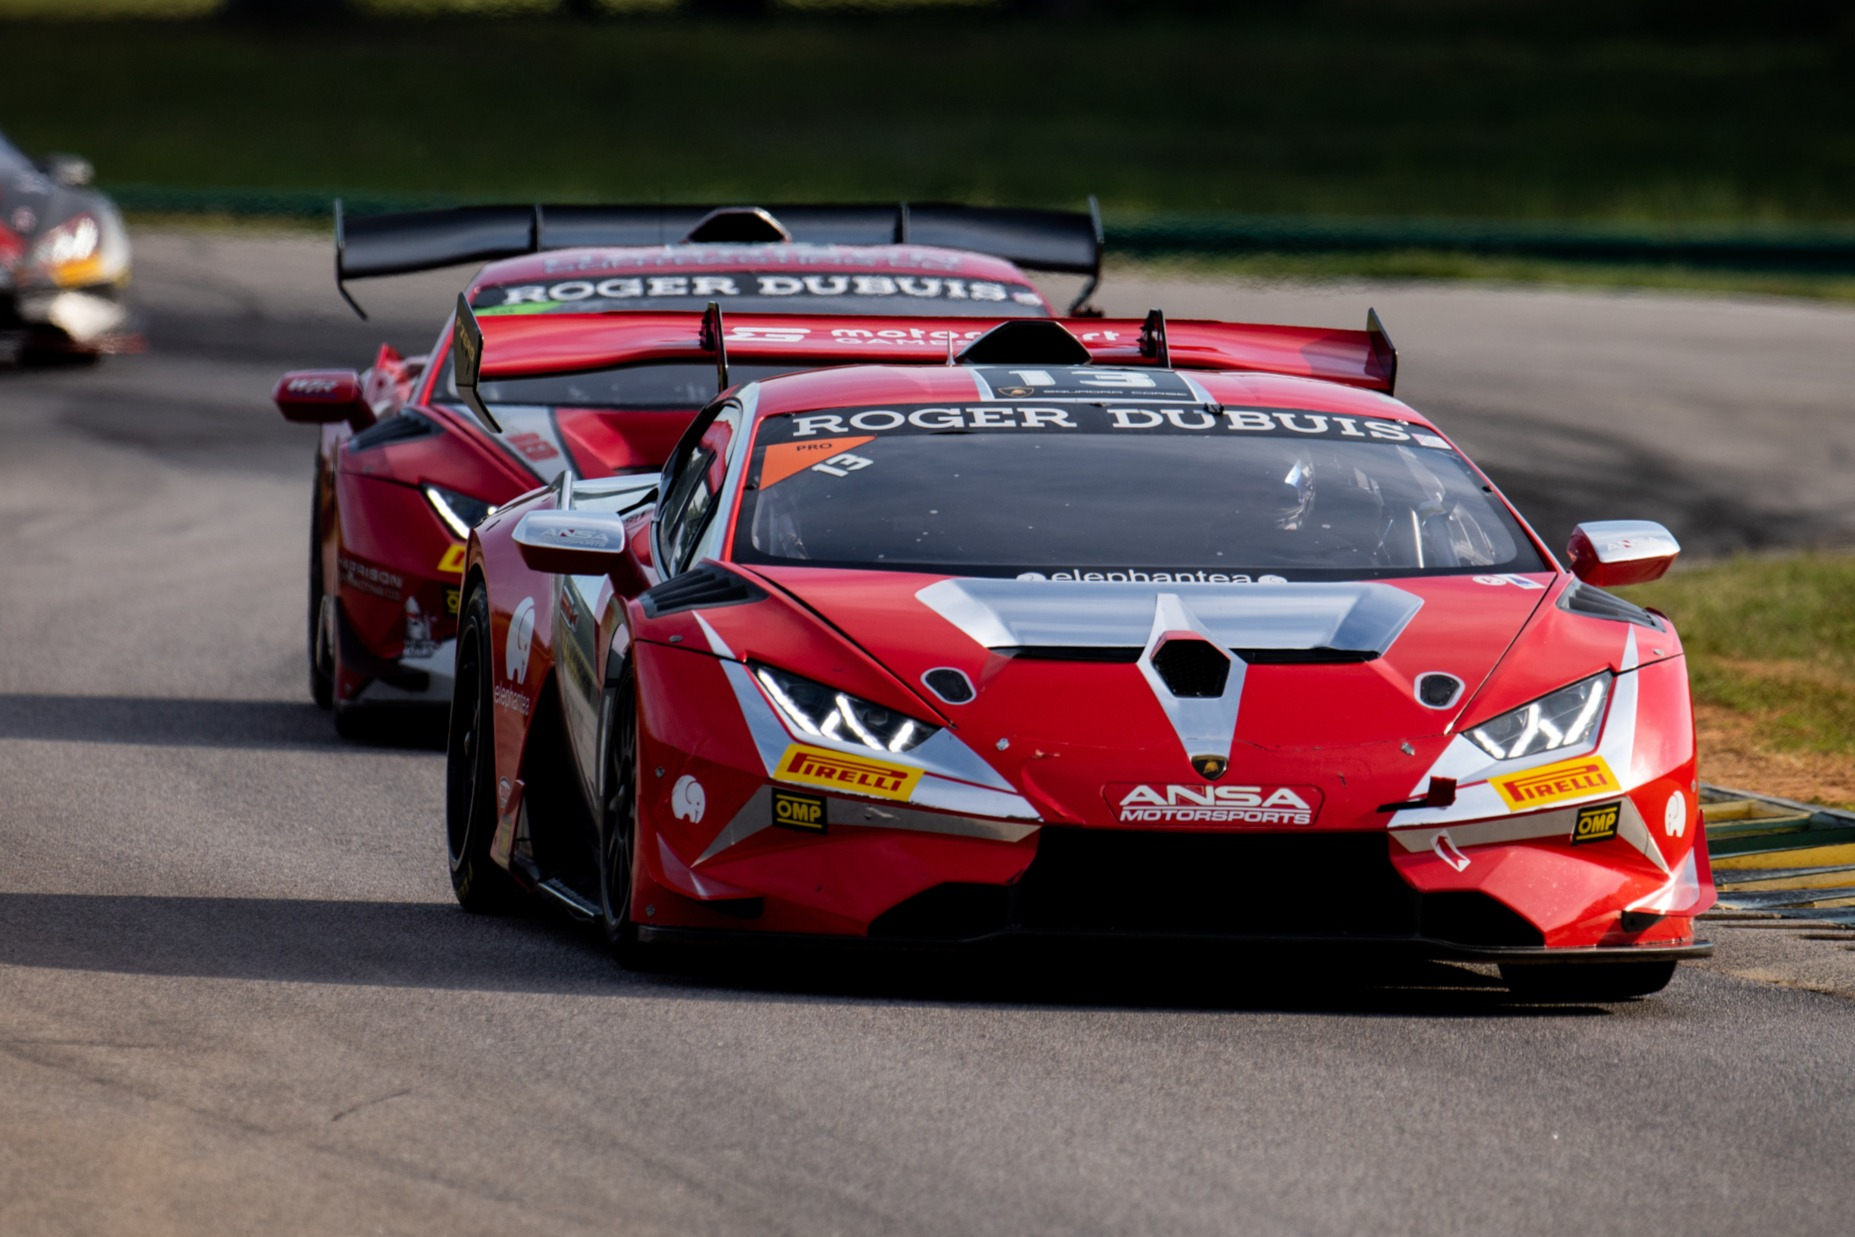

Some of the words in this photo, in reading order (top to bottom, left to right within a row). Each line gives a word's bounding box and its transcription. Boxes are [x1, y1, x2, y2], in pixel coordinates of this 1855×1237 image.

[503, 277, 739, 305] ROGER
[757, 275, 1006, 301] DUBUIS
[831, 328, 1120, 341] motorrt
[1008, 370, 1156, 387] 13
[793, 407, 1077, 437] ROGER
[1106, 408, 1410, 441] DUBUIS
[796, 442, 833, 452] PRO
[811, 453, 874, 478] 13
[1051, 569, 1251, 583] elephantea
[494, 681, 530, 716] elephantea
[786, 752, 908, 792] PIRELLI
[1502, 764, 1608, 802] PIRELLI
[1119, 785, 1310, 810] ANSA
[776, 800, 822, 823] OMP
[1120, 809, 1310, 825] MOTORSPORTS
[1578, 812, 1616, 834] OMP
